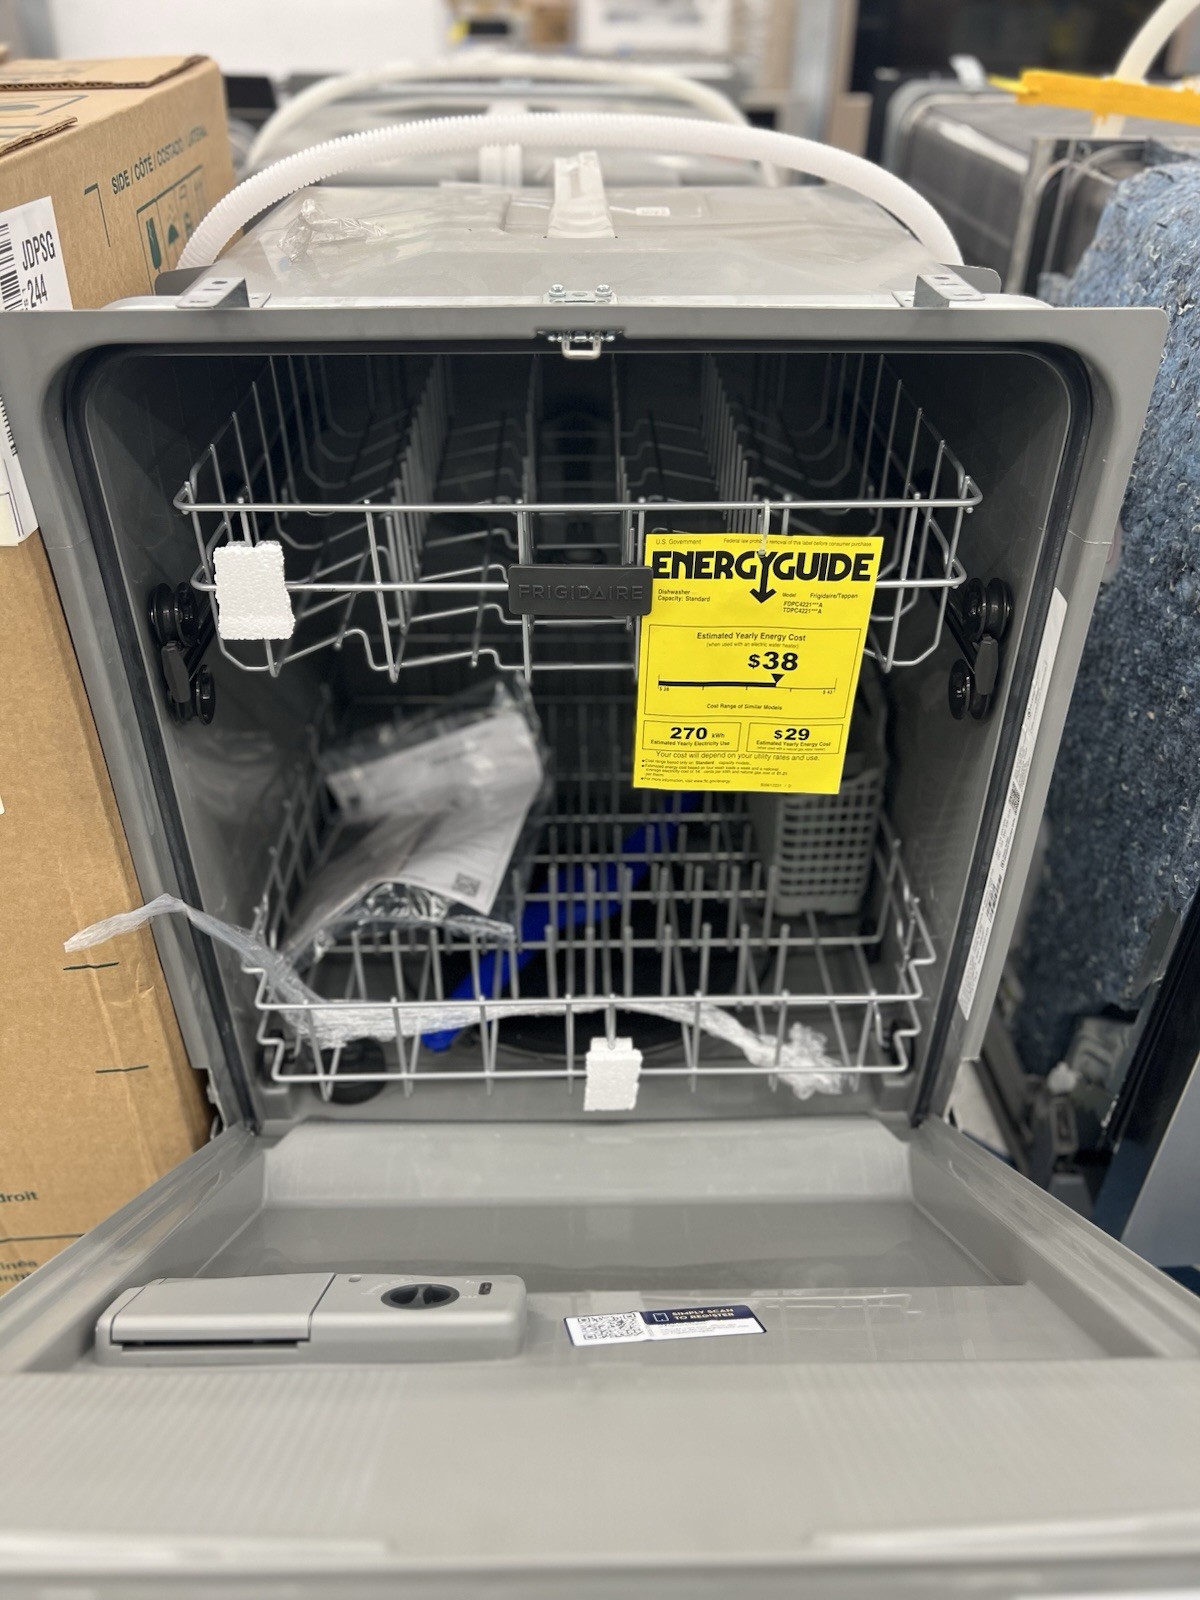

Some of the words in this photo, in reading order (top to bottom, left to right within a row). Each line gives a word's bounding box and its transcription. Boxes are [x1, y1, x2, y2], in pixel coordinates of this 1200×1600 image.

[111, 169, 131, 195] SIDE
[134, 152, 154, 181] CÔTÉ
[22, 230, 56, 271] JDPSG
[27, 274, 48, 309] 244
[653, 551, 875, 582] ENERGYGUIDE
[518, 584, 643, 600] FRIGIDAIRE
[810, 592, 858, 600] Frigidaire/Tappan
[697, 632, 734, 640] Estimated
[735, 632, 758, 641] Yearly
[760, 632, 786, 642] Energy
[788, 634, 806, 642] Cost
[748, 651, 799, 671] $38
[670, 727, 708, 740] 270
[773, 728, 810, 741] $29
[656, 750, 672, 758] Your
[753, 753, 771, 761] utility
[672, 1309, 705, 1317] SIMPLY
